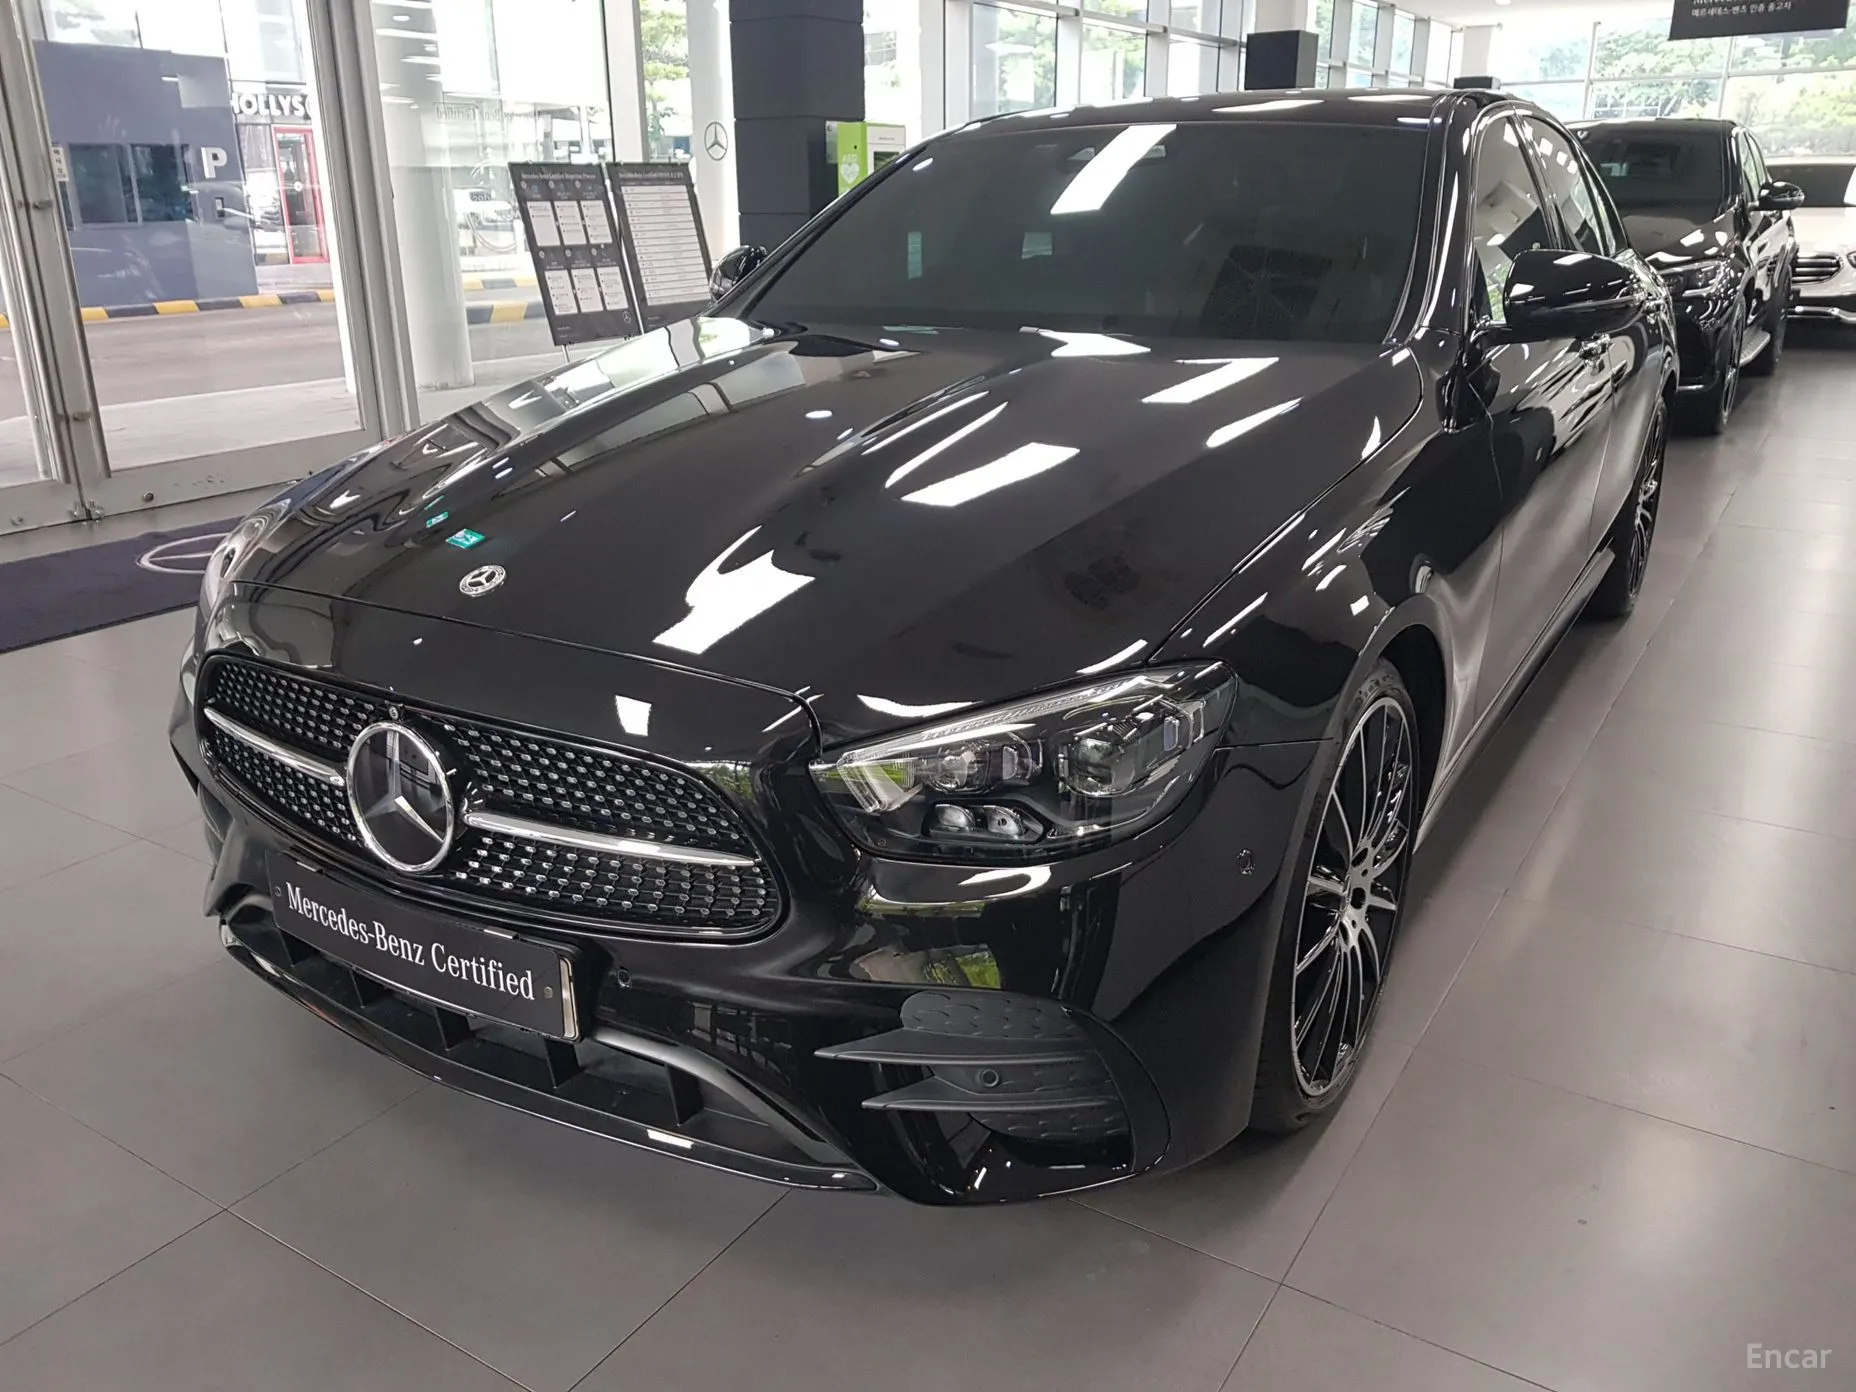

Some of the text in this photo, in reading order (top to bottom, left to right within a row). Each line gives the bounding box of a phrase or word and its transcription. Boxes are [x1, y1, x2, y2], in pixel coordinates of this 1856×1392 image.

[201, 146, 228, 179] P
[285, 881, 535, 1001] Mercedes-Benz Certified
